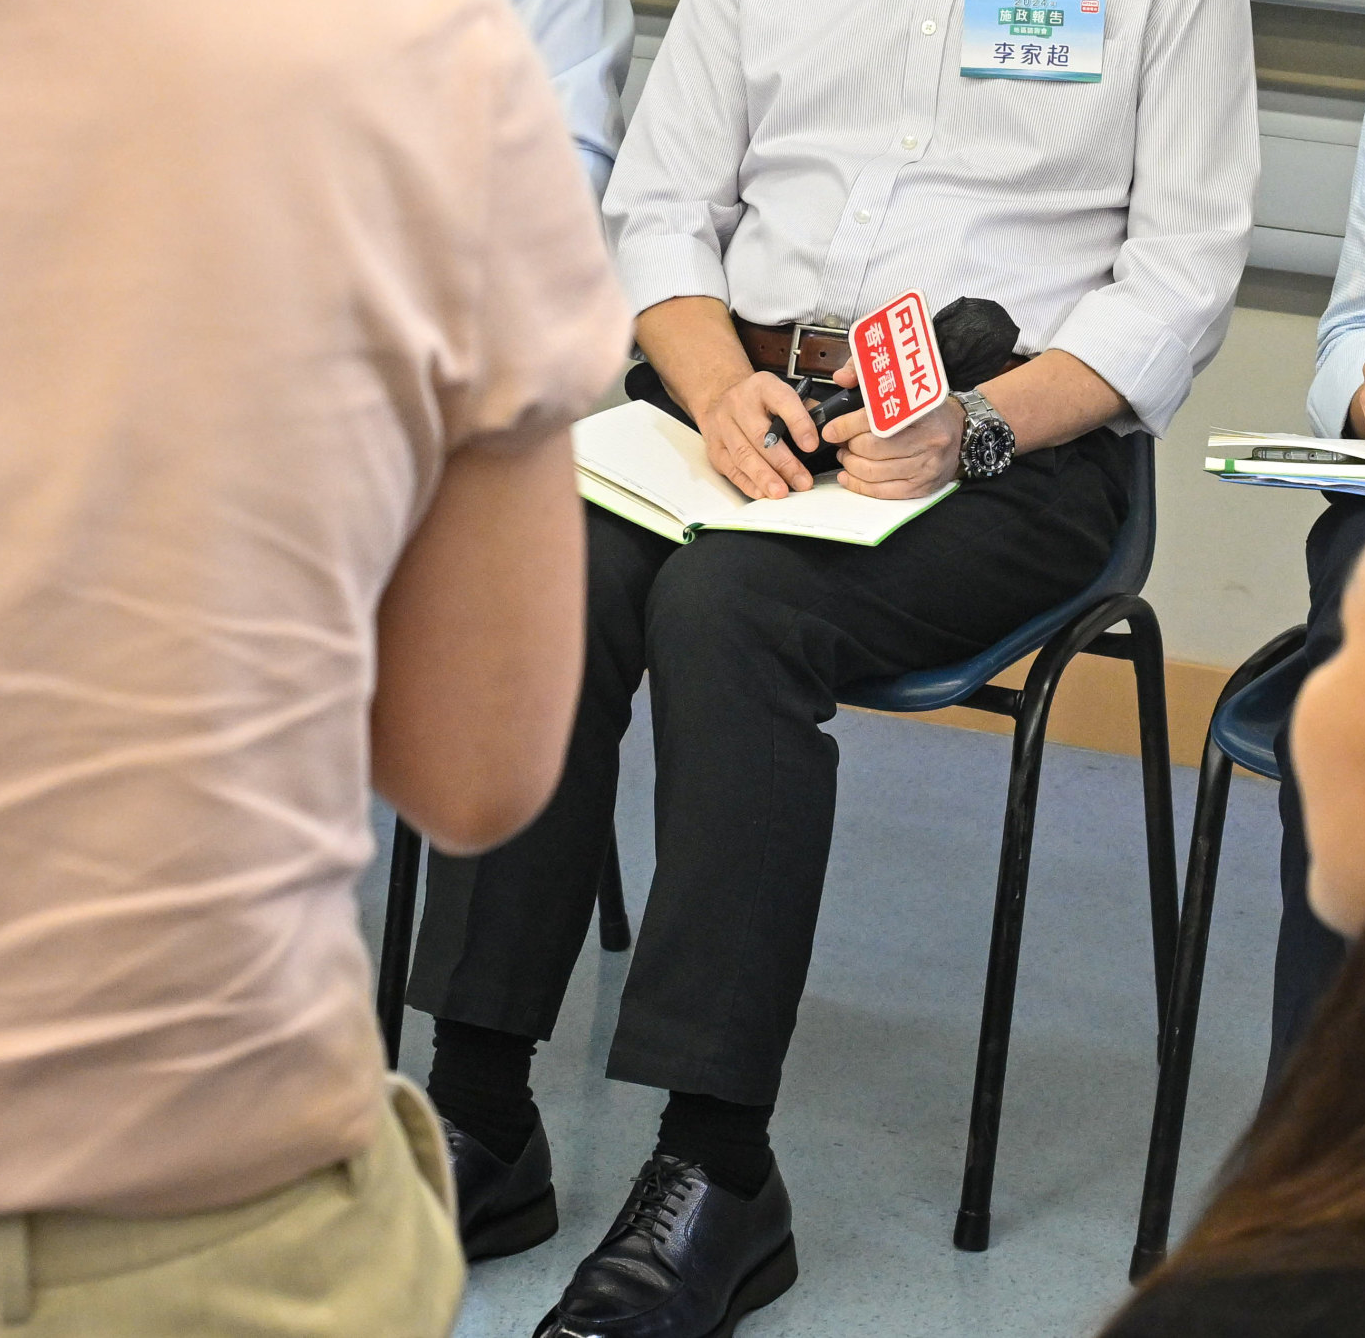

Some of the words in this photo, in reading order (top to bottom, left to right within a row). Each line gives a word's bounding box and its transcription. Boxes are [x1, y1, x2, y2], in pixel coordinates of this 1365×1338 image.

[999, 8, 1064, 25] 施政報告
[993, 42, 1070, 67] 李家超
[864, 321, 902, 420] 香港電台
[894, 305, 931, 402] RTHK
